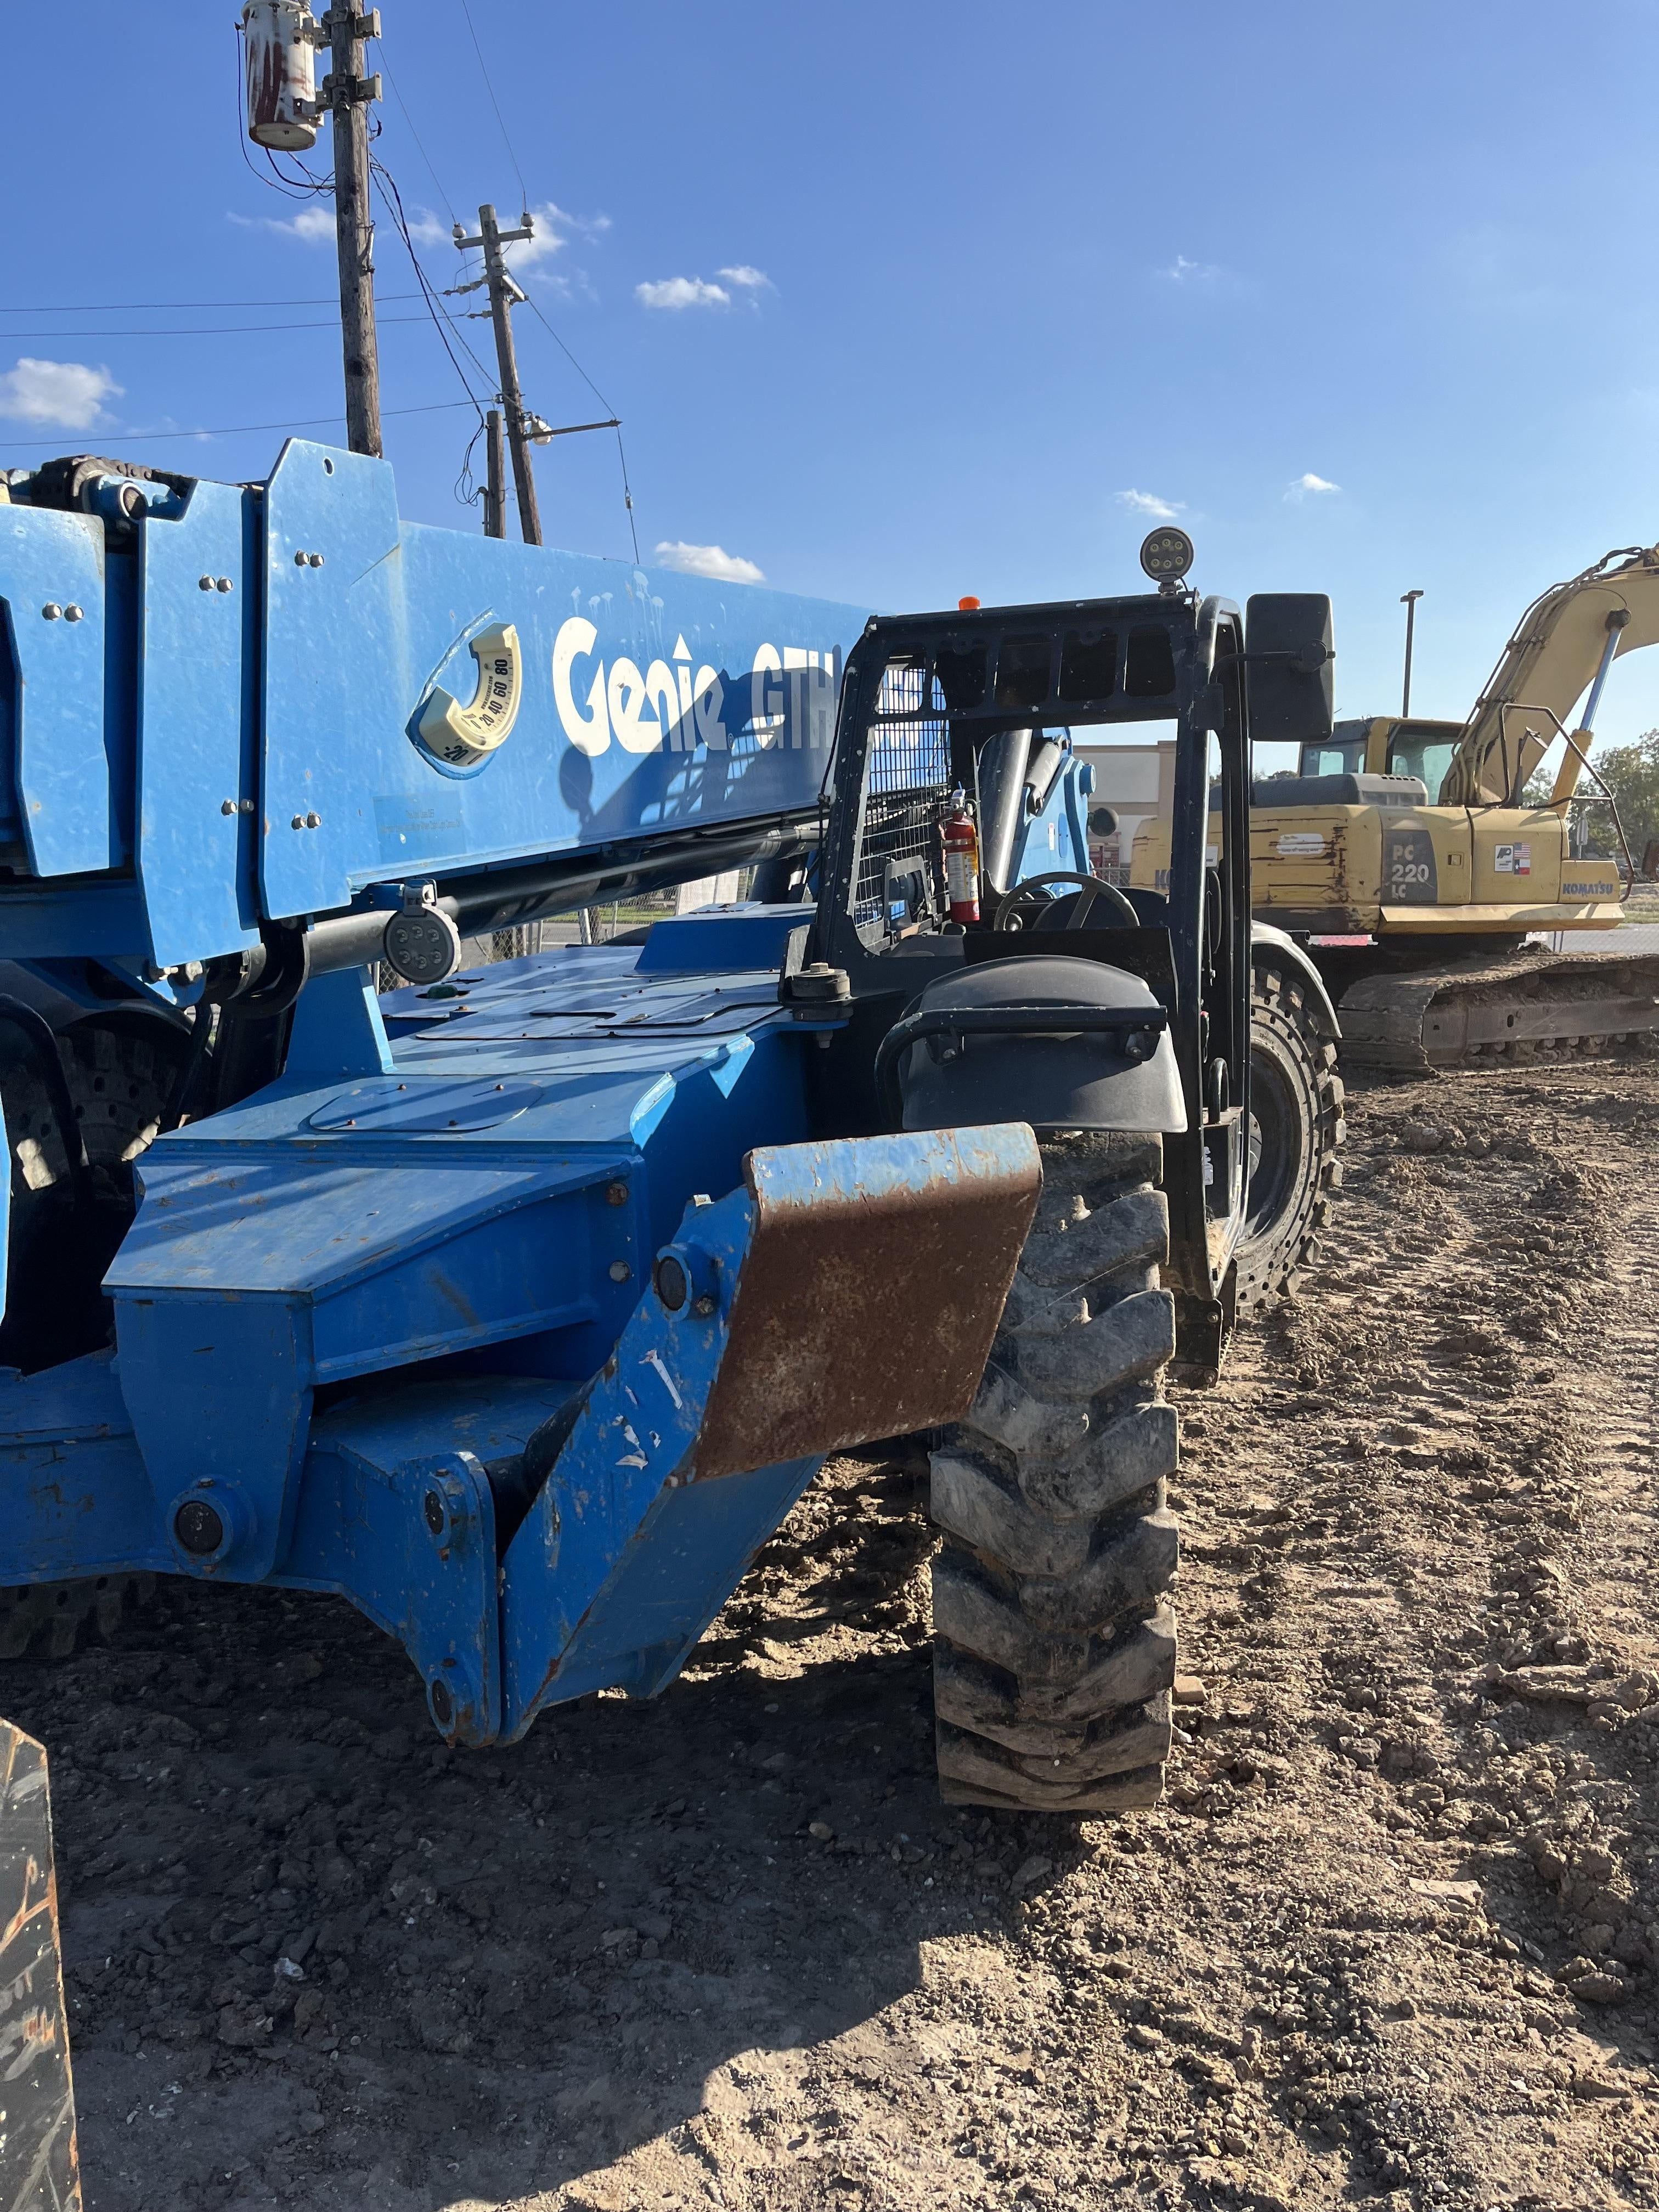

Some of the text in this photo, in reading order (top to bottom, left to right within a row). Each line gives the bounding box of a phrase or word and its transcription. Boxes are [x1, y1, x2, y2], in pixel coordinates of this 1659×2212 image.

[495, 658, 508, 675] 80
[493, 681, 507, 697] 60
[552, 617, 726, 757] Genie
[488, 700, 503, 715] 40
[479, 714, 494, 727] 20
[1393, 844, 1414, 861] PC
[1391, 864, 1429, 883] 220
[1391, 884, 1407, 900] LC
[1563, 882, 1613, 895] KOMATSU
